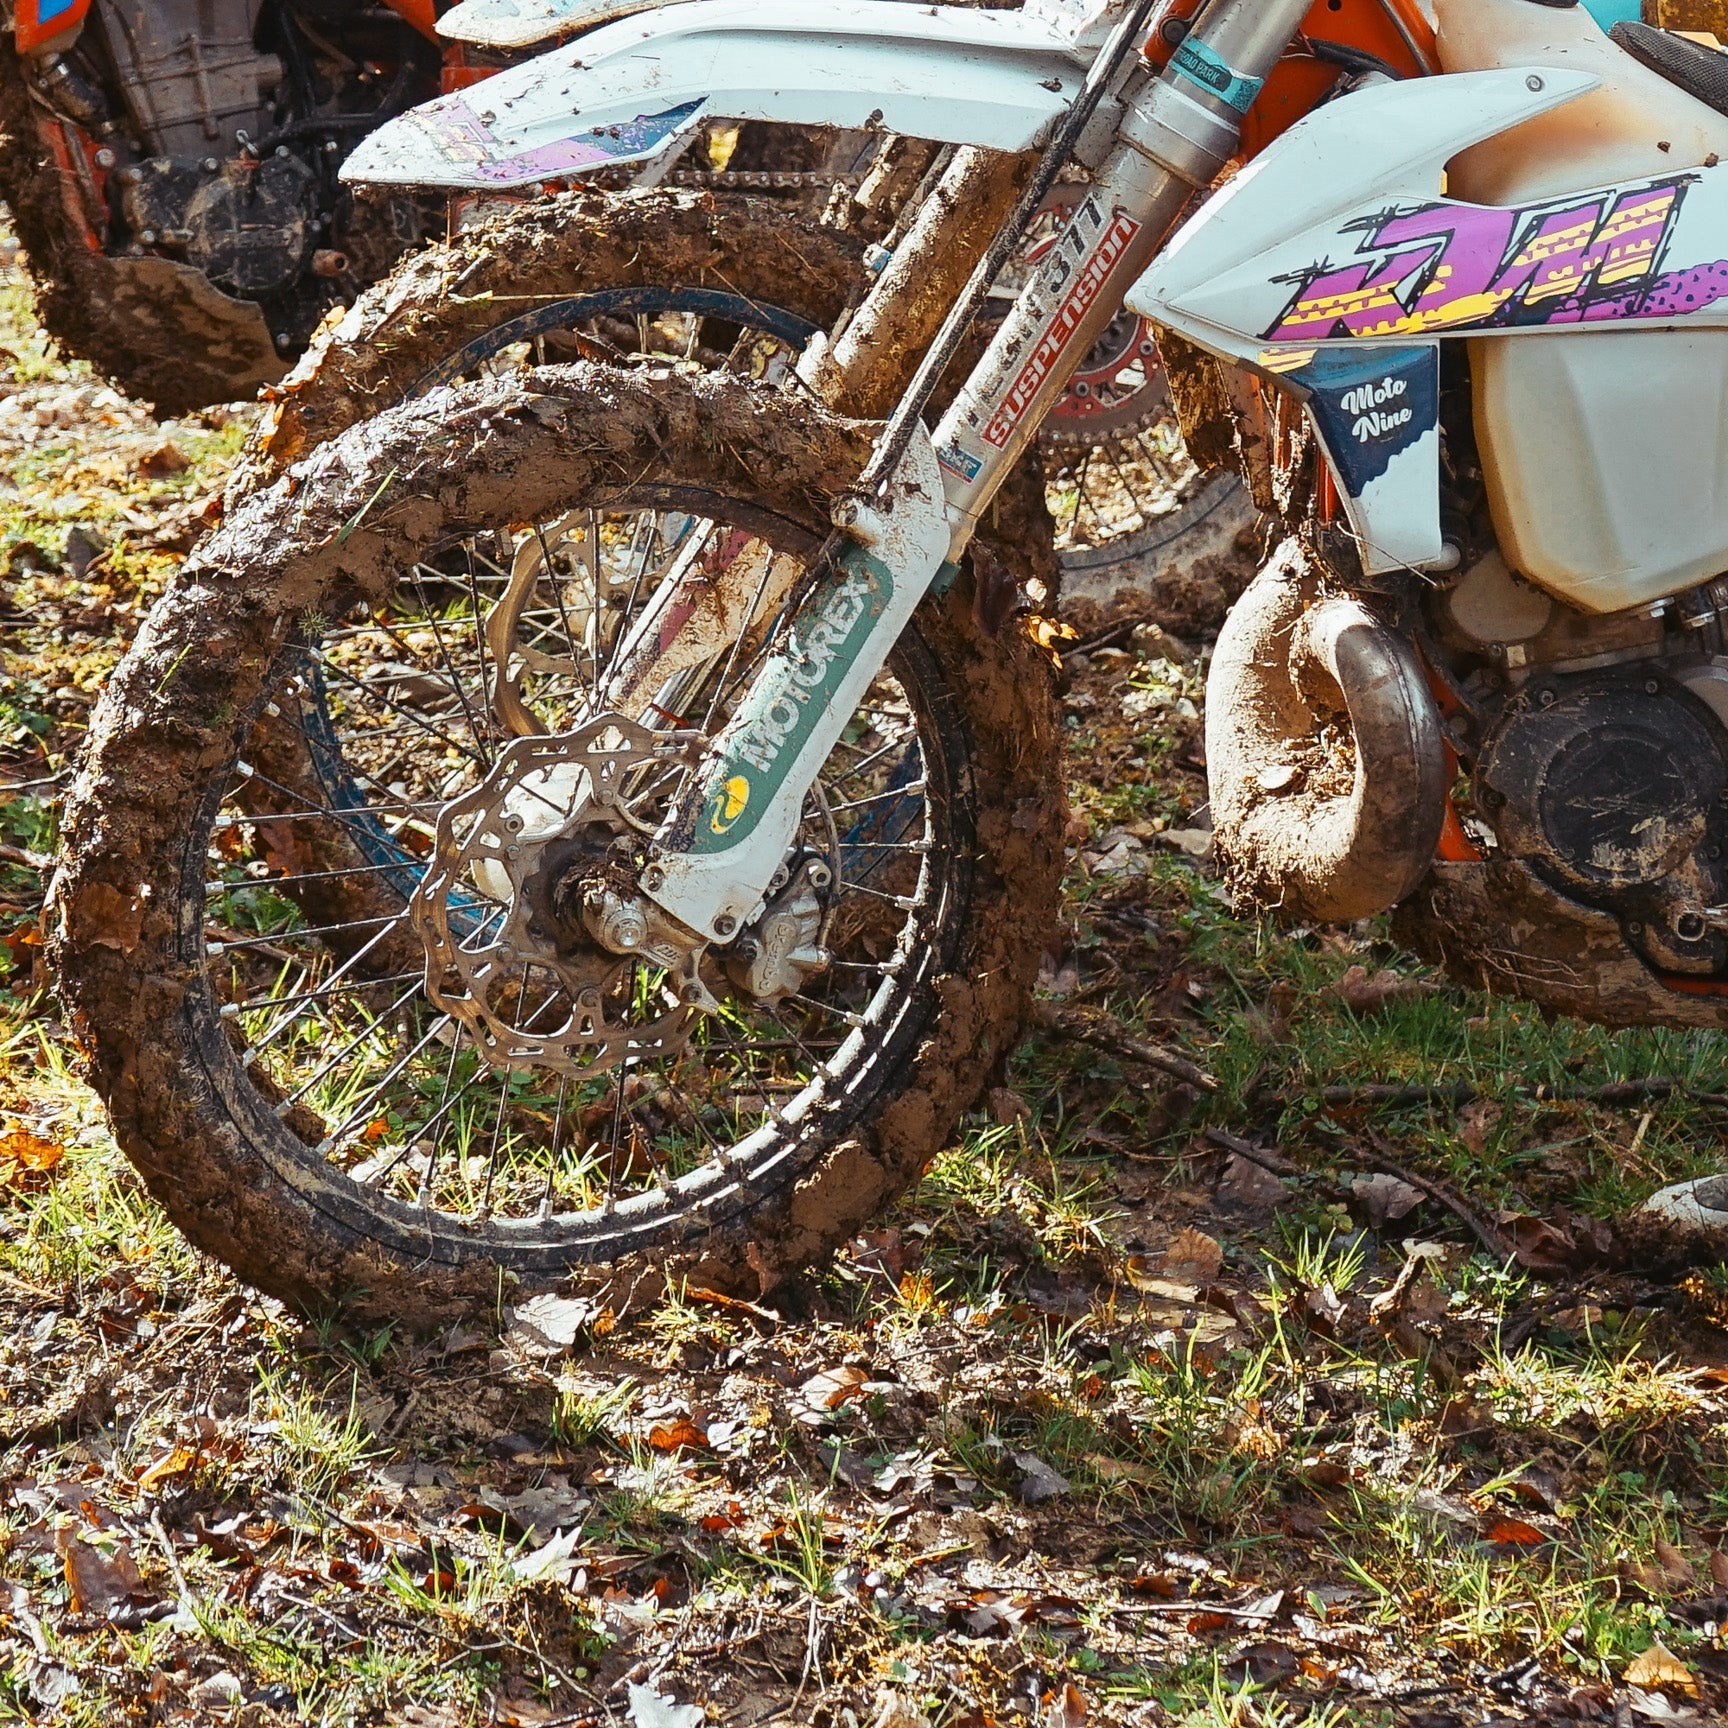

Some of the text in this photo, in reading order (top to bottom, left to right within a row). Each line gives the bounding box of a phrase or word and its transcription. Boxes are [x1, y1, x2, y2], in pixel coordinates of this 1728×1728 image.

[986, 213, 1136, 448] SUSPENSION
[1259, 178, 1697, 340] KTM
[1340, 377, 1407, 415] Moto
[1352, 408, 1413, 443] Nine
[739, 572, 871, 773] MOTOREX
